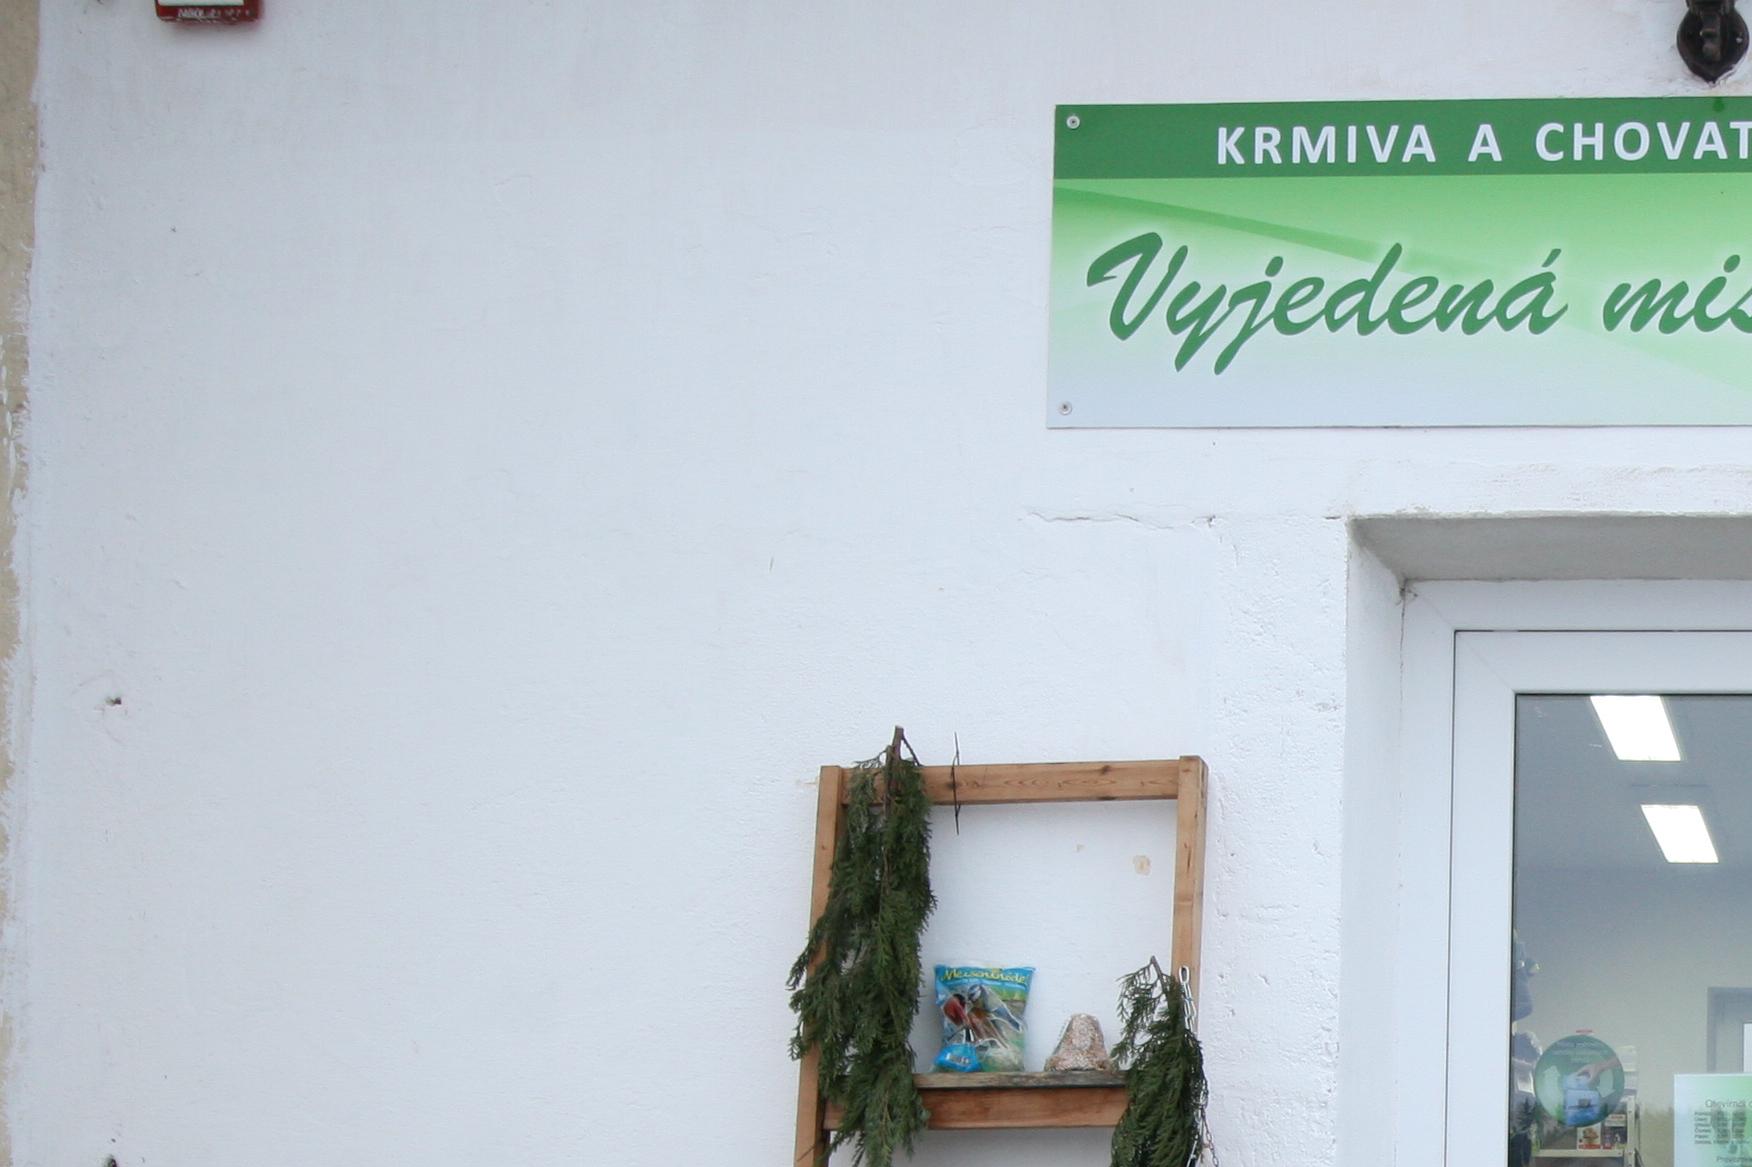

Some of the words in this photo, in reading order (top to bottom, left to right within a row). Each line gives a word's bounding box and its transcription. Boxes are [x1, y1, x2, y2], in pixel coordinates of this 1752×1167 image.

[1216, 124, 1436, 166] KRMIVA
[1467, 124, 1503, 163] A
[1086, 231, 1568, 375] Vyjedená
